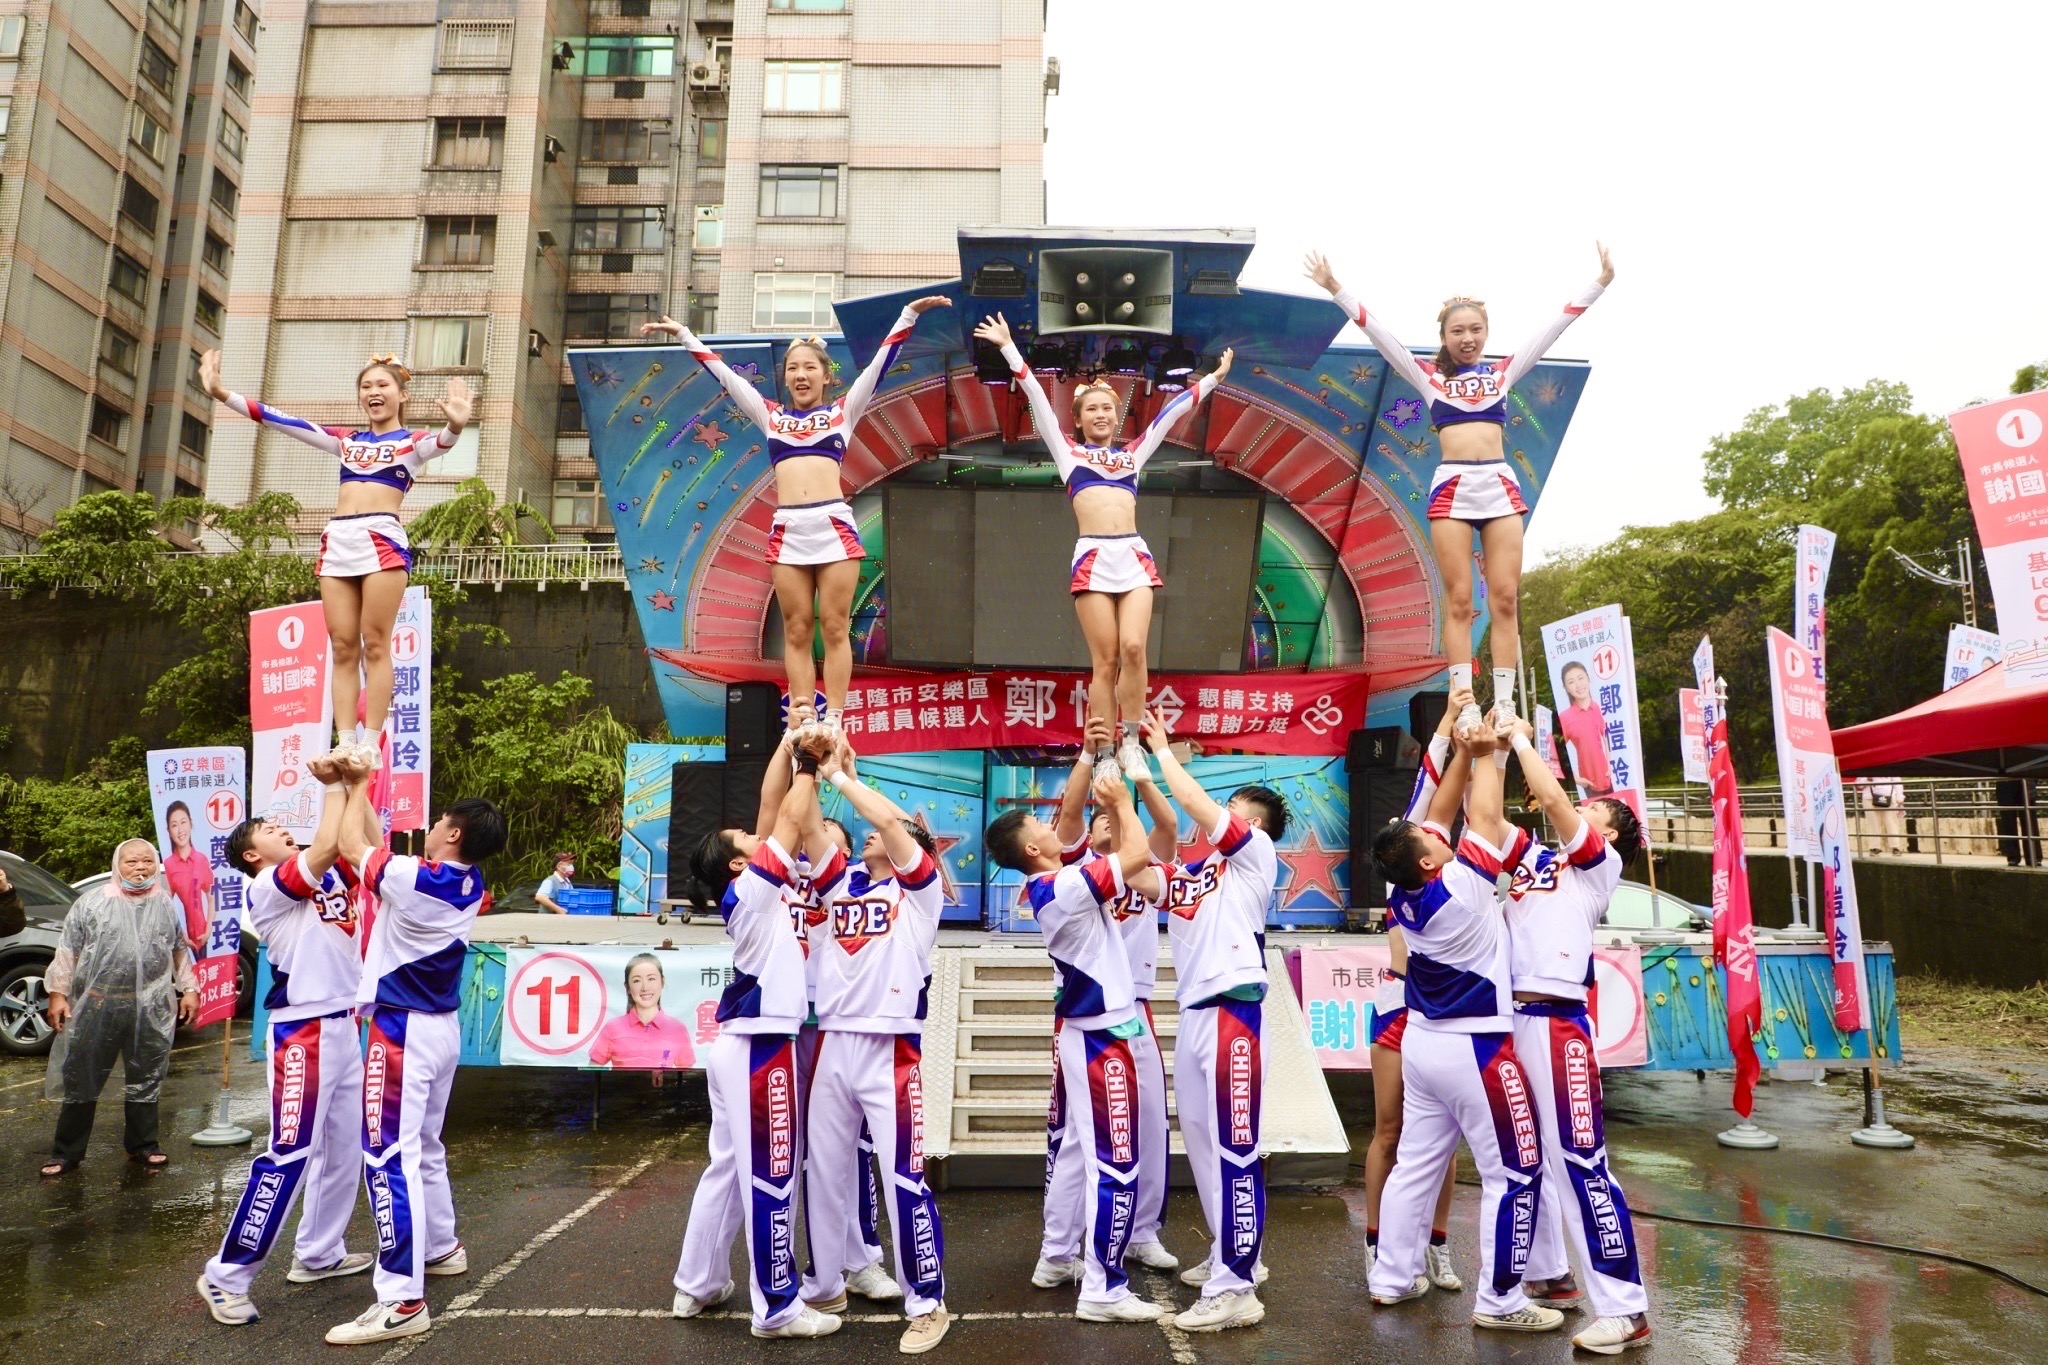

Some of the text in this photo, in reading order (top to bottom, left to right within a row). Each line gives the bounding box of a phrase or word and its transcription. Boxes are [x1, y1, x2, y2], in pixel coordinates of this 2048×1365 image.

[1445, 376, 1499, 398] TPE
[779, 414, 831, 434] TPE
[2004, 415, 2025, 441] 1
[346, 445, 395, 463] TPE
[1979, 454, 2039, 476] 市長候選人
[1983, 469, 2048, 505] 謝國
[284, 621, 297, 643] 1
[391, 632, 415, 654] 11
[1556, 629, 1614, 655] 市議員候選人
[1569, 616, 1603, 637] 安樂區
[261, 656, 300, 669] 市長候選人
[1593, 650, 1613, 675] 11
[843, 677, 989, 710] 基隆市安樂區
[1004, 677, 1186, 736] 鄭玲
[1198, 688, 1294, 712] 懇請支持
[843, 704, 990, 735] 市議員候選人
[1197, 713, 1289, 735] 感謝力挺
[1599, 683, 1630, 787] 鄭愷玲
[164, 773, 239, 791] 市議員候選人
[181, 756, 226, 772] 安樂區
[208, 797, 235, 823] 11
[1169, 864, 1218, 908] TPE
[832, 899, 891, 938] TPE
[526, 975, 580, 1035] 11
[276, 1044, 306, 1146] CHINESE
[367, 1041, 386, 1147] CHINESE
[1104, 1057, 1132, 1163] CHINESE
[1230, 1037, 1252, 1145] CHINESE
[1565, 1038, 1595, 1149] CHINESE
[767, 1066, 791, 1178] CHINESE
[908, 1064, 924, 1174] CHINESE
[1498, 1060, 1539, 1168] CHINESE
[238, 1172, 285, 1251] TAIPEI
[372, 1171, 397, 1252] TAIPEI
[1232, 1174, 1257, 1257] TAIPEI
[1584, 1175, 1627, 1260] TAIPEI
[771, 1206, 792, 1291] TAIPEI
[912, 1200, 939, 1284] TAIPEI
[1510, 1191, 1534, 1274] TAIPEI
